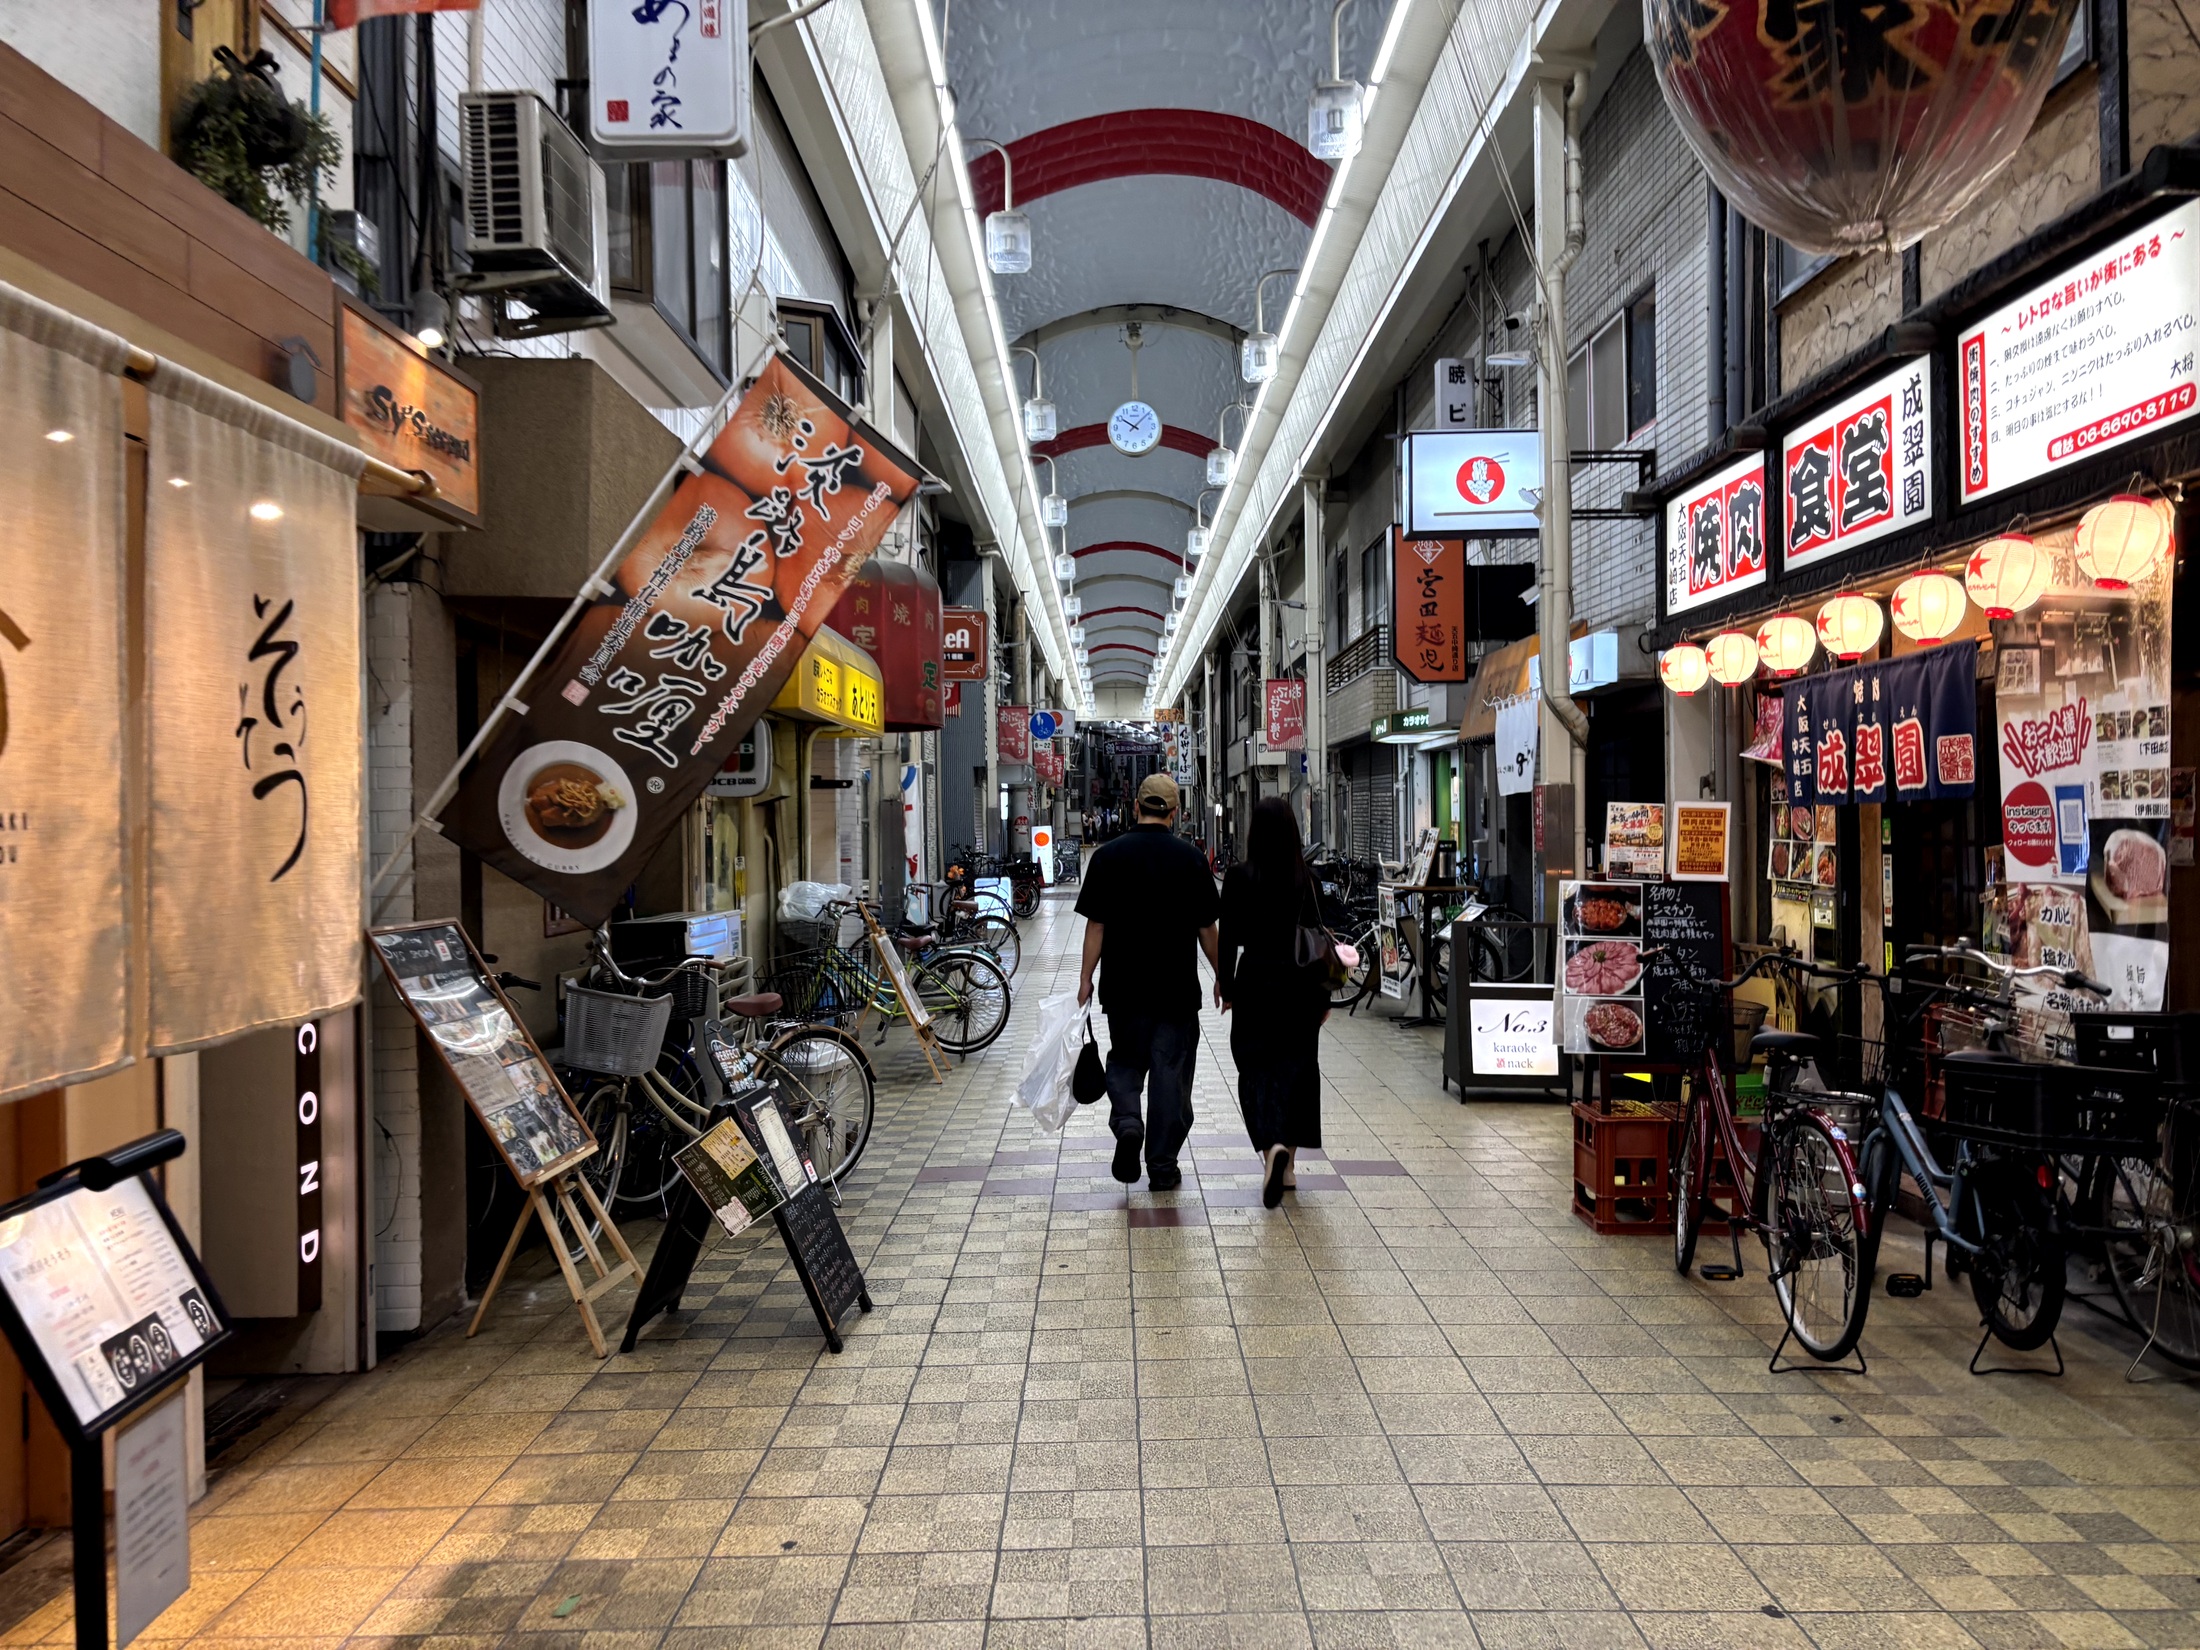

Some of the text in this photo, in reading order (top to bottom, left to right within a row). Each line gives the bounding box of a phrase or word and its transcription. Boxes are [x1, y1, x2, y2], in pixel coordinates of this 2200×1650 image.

[2170, 352, 2194, 380] 大将
[1448, 365, 1466, 422] 暁ビ
[1968, 344, 1982, 484] 街焼肉のすすめ
[2051, 387, 2191, 459] 電話 06-6690-8119
[1790, 407, 1890, 551] 食堂
[1677, 502, 1687, 583] 大阪天五
[1690, 480, 1763, 591] 焼肉
[579, 502, 718, 686] 淡路島活性化推進委員会
[1669, 547, 1678, 607] 中崎店
[852, 683, 877, 725] あとりえ
[1853, 677, 1880, 704] 焼肉
[1797, 694, 1812, 776] 大阪天五
[2023, 706, 2077, 748] お一人様
[2033, 736, 2076, 772] 大歓迎
[2041, 948, 2076, 969] 塩たん
[1477, 1010, 1548, 1034] No.3
[715, 1048, 742, 1062] PERFECT
[1493, 1042, 1537, 1053] karaoke
